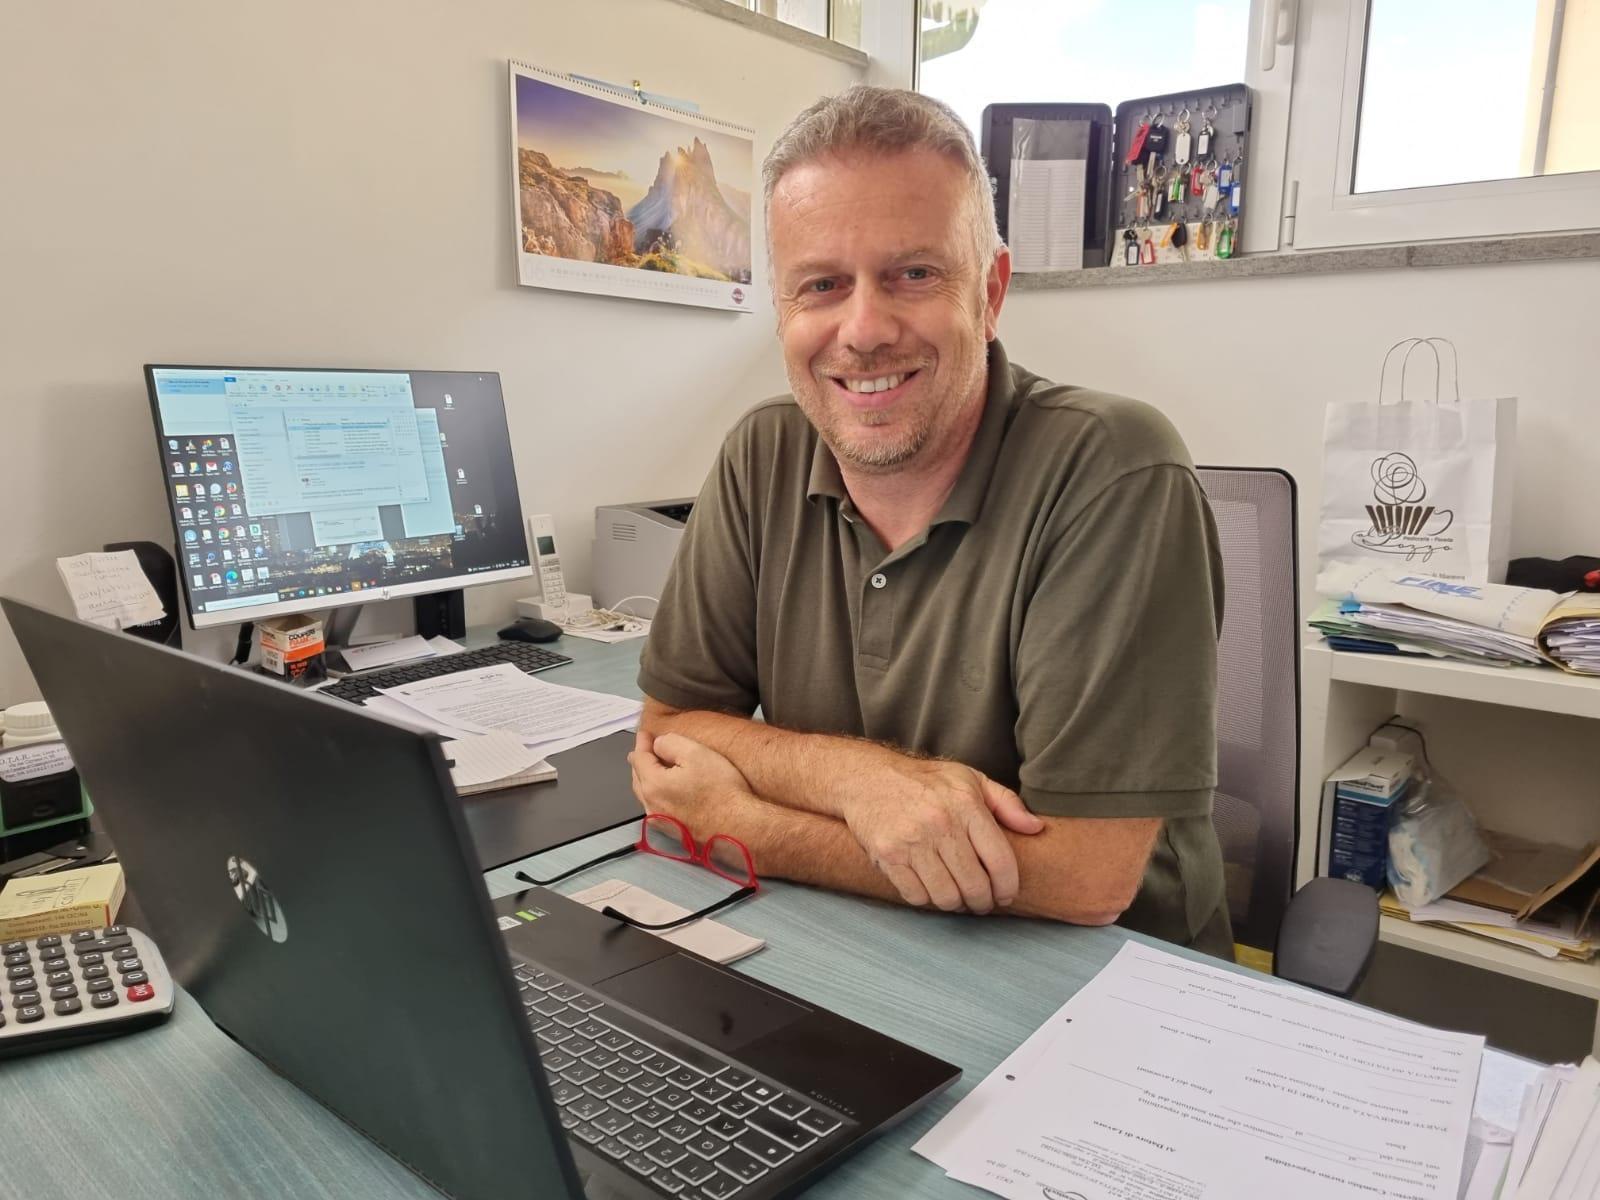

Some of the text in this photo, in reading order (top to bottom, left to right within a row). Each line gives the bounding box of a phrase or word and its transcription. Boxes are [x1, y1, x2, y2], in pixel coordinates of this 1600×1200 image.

[648, 1110, 660, 1118] E
[671, 1125, 686, 1135] W
[722, 1122, 734, 1130] A
[1093, 1120, 1122, 1135] Lavoro
[702, 1141, 714, 1150] Q
[1135, 1135, 1164, 1148] Datore
